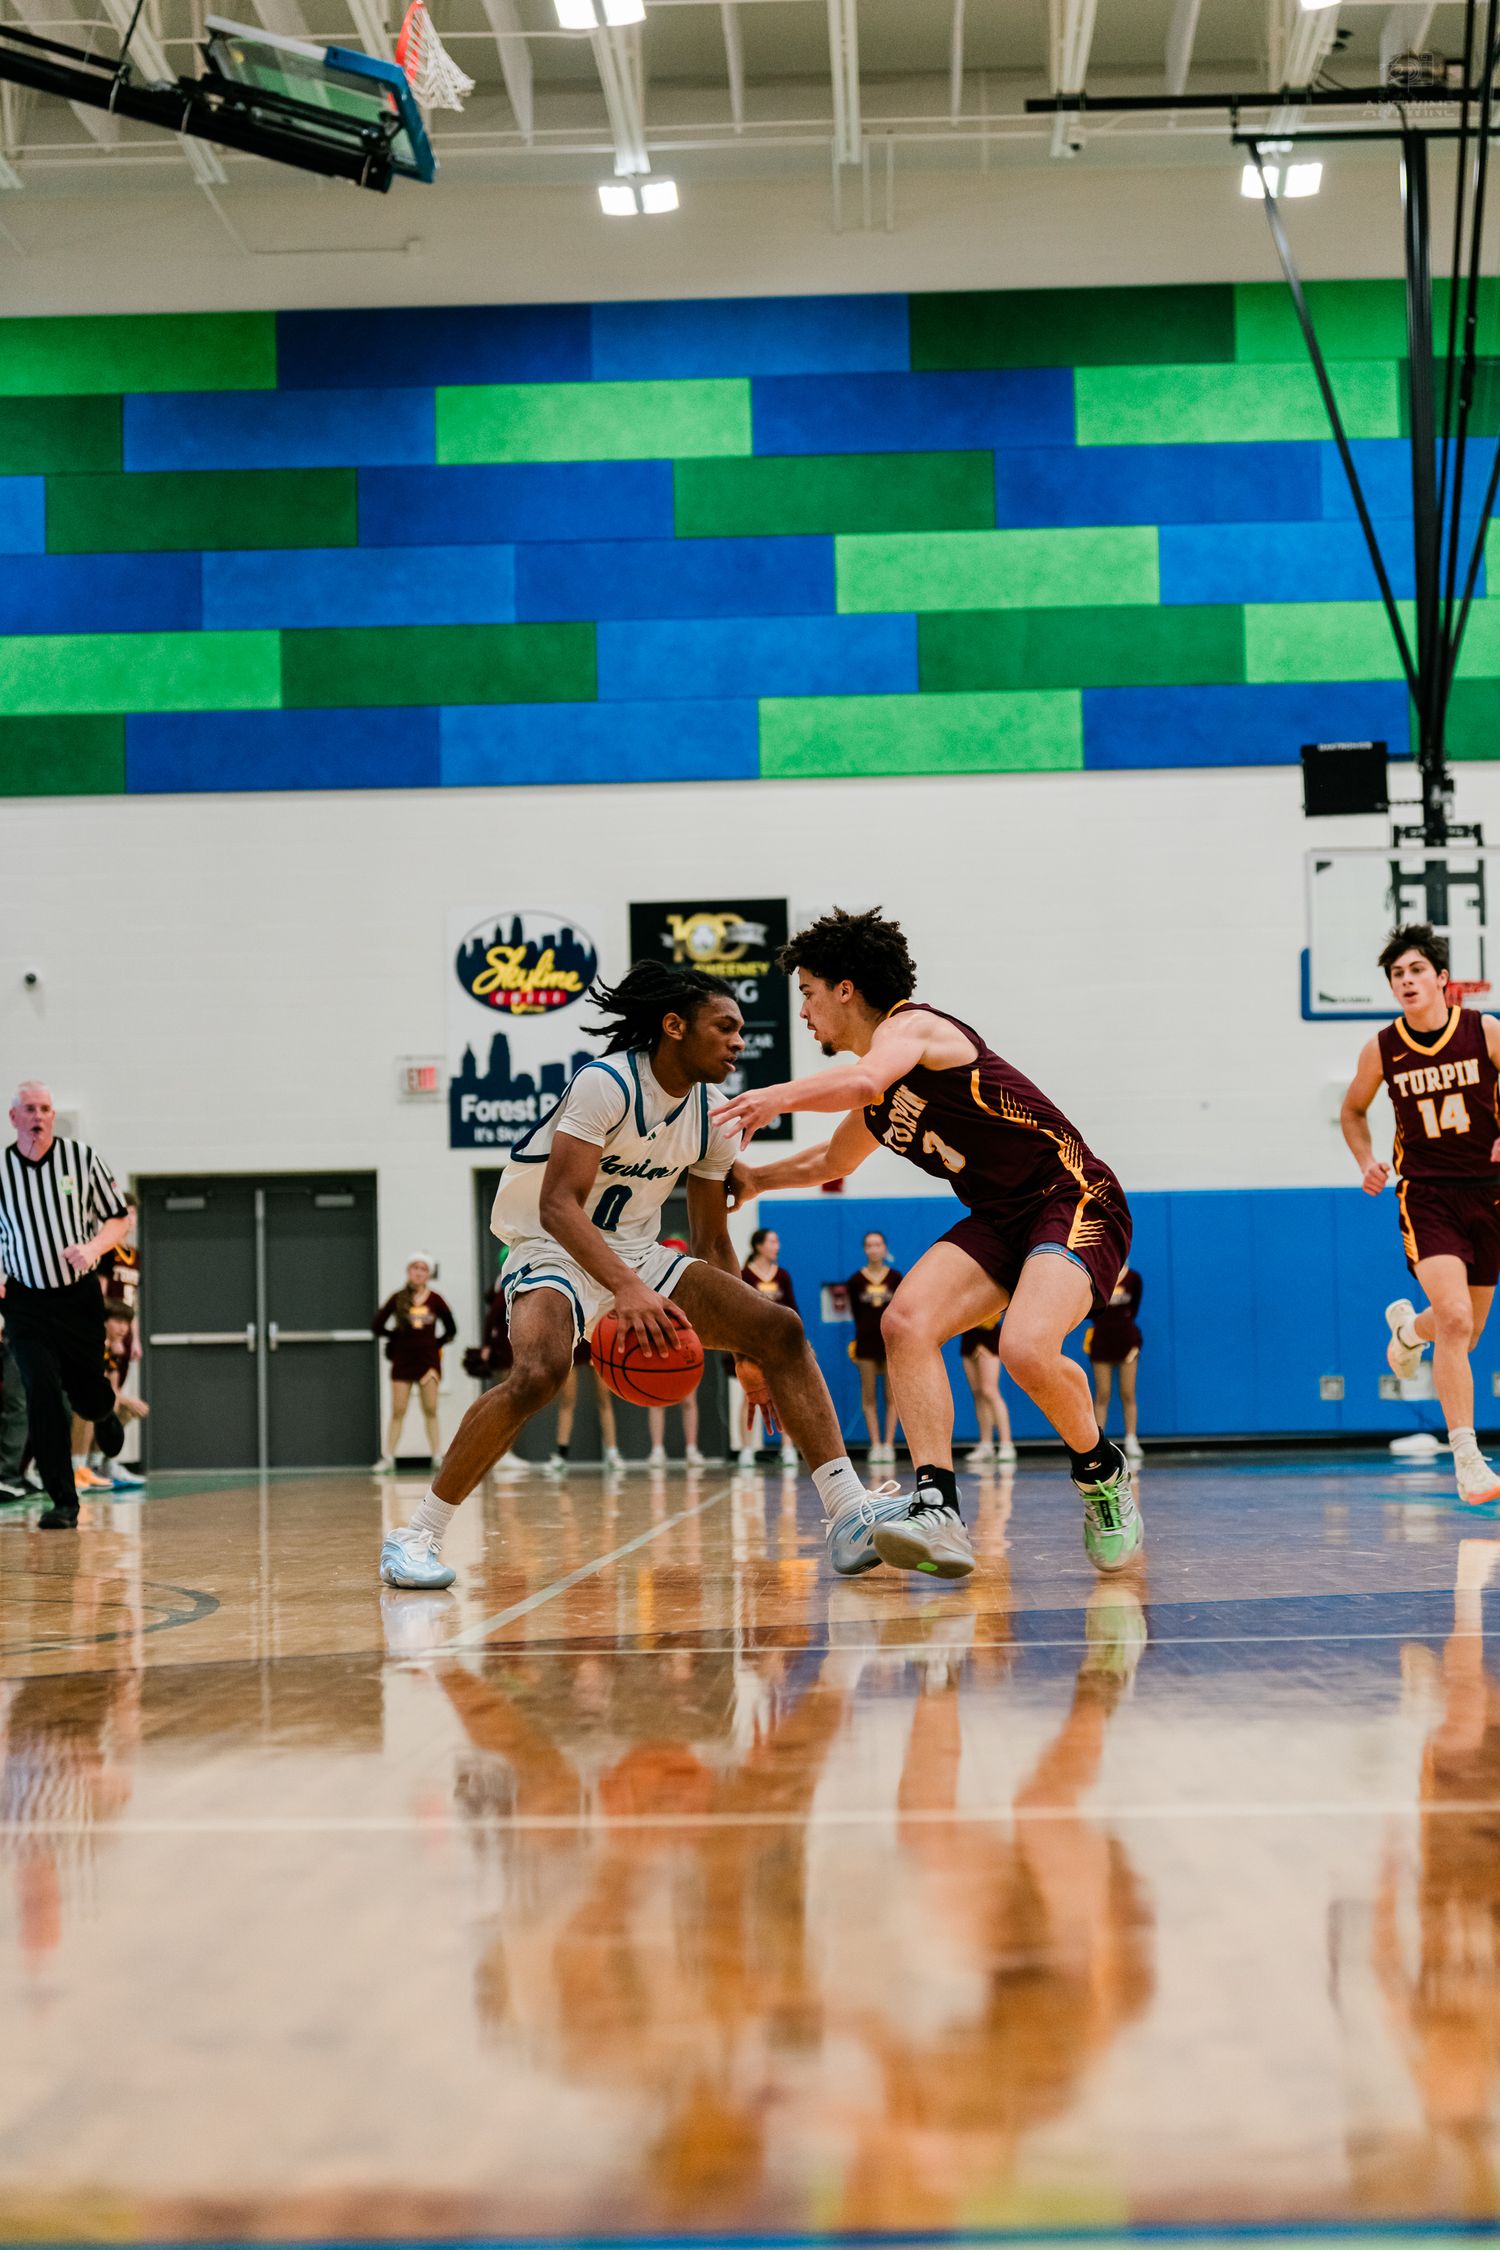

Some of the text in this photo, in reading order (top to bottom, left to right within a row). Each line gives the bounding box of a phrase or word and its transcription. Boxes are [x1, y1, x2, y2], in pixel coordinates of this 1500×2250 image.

[472, 945, 584, 995] Skyline
[1393, 1058, 1480, 1097] TURPIN
[461, 1094, 537, 1122] Forest
[1417, 1092, 1471, 1139] 14
[474, 1127, 495, 1143] It's
